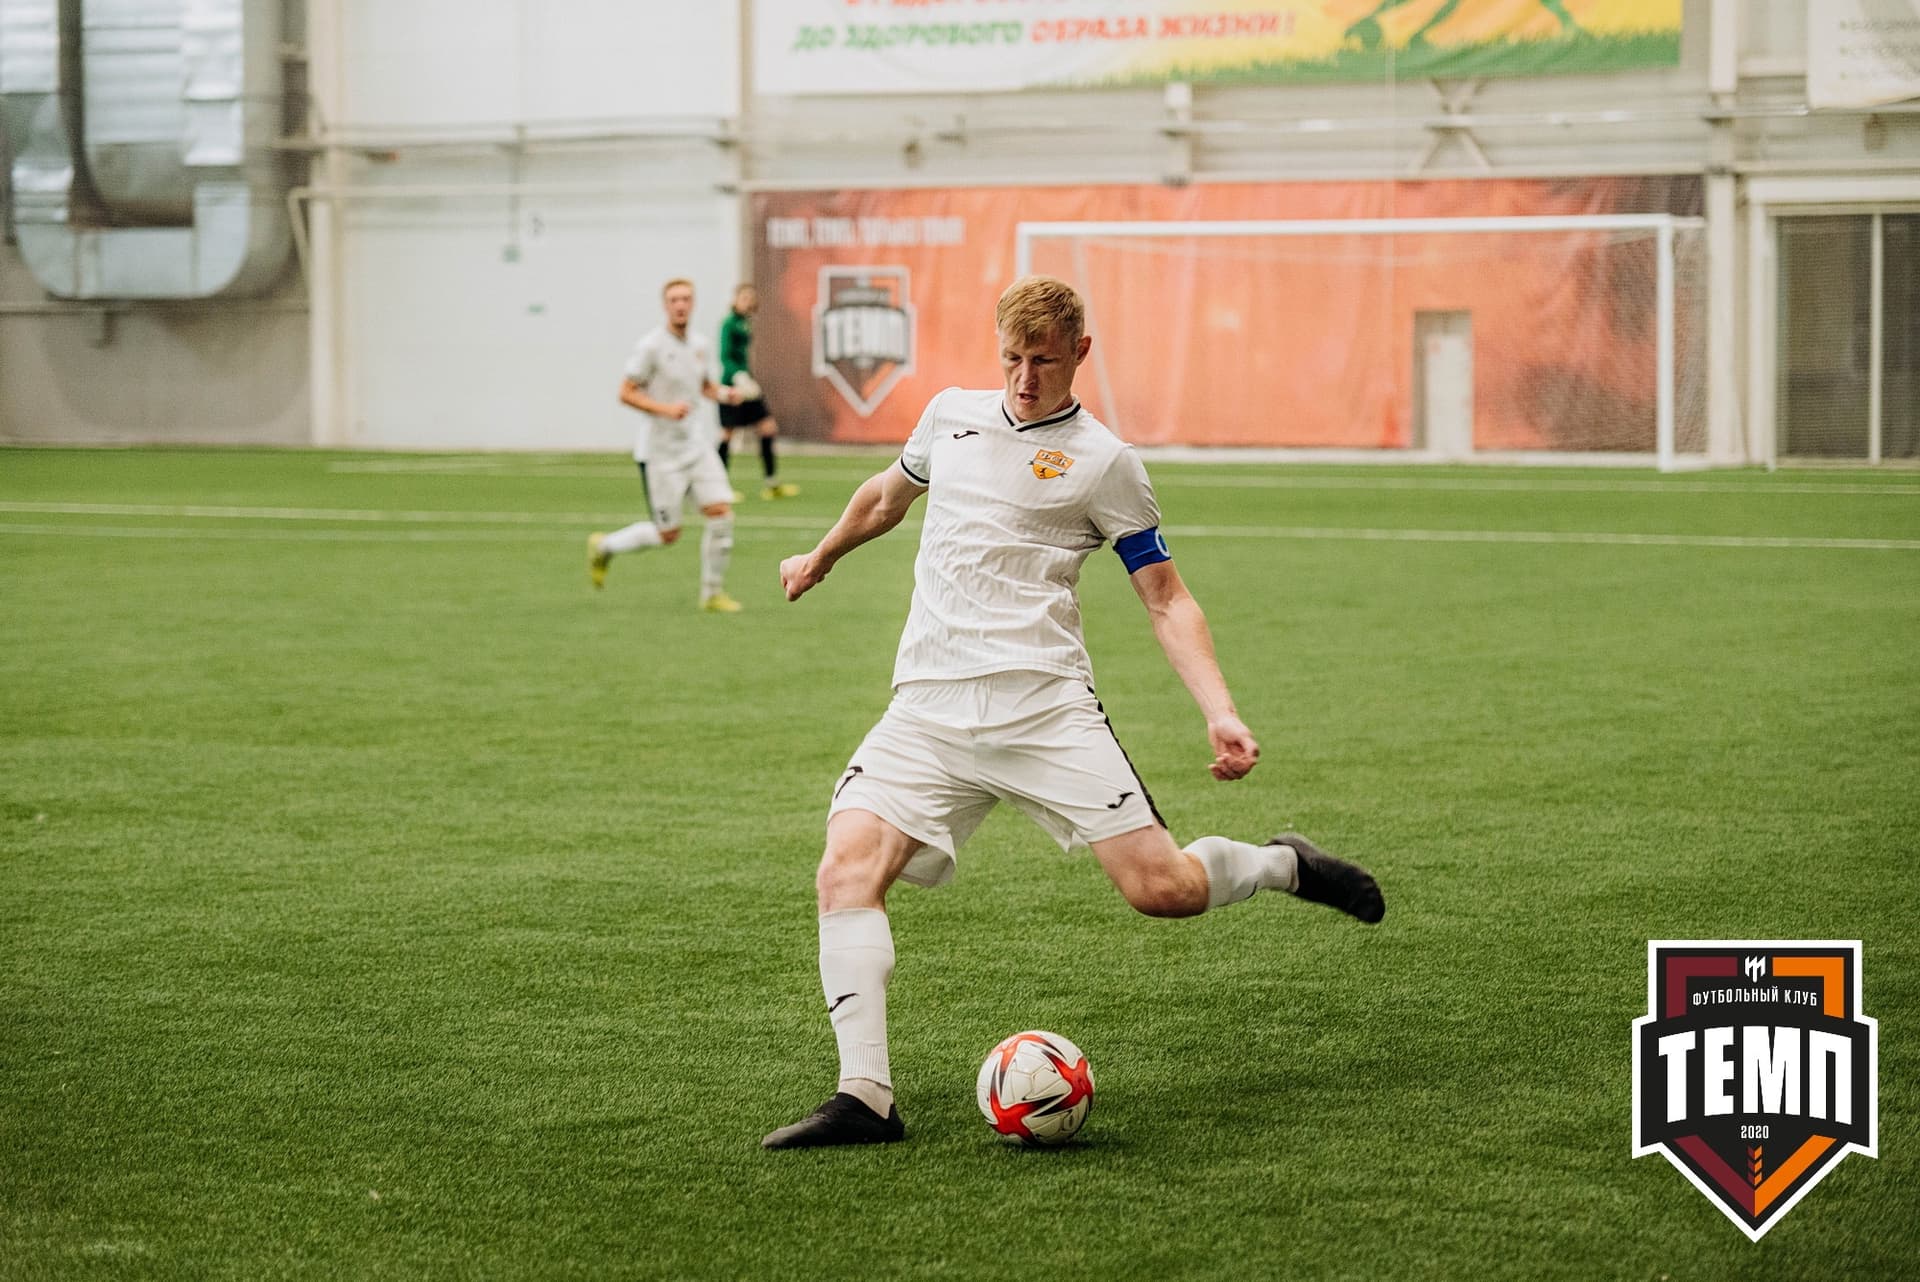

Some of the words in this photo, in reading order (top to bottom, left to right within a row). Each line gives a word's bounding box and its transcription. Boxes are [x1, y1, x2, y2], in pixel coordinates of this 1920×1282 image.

[793, 24, 835, 50] ДО
[846, 20, 1023, 48] ЗДОРОВОГО
[1031, 17, 1149, 43] ОБРАЗА
